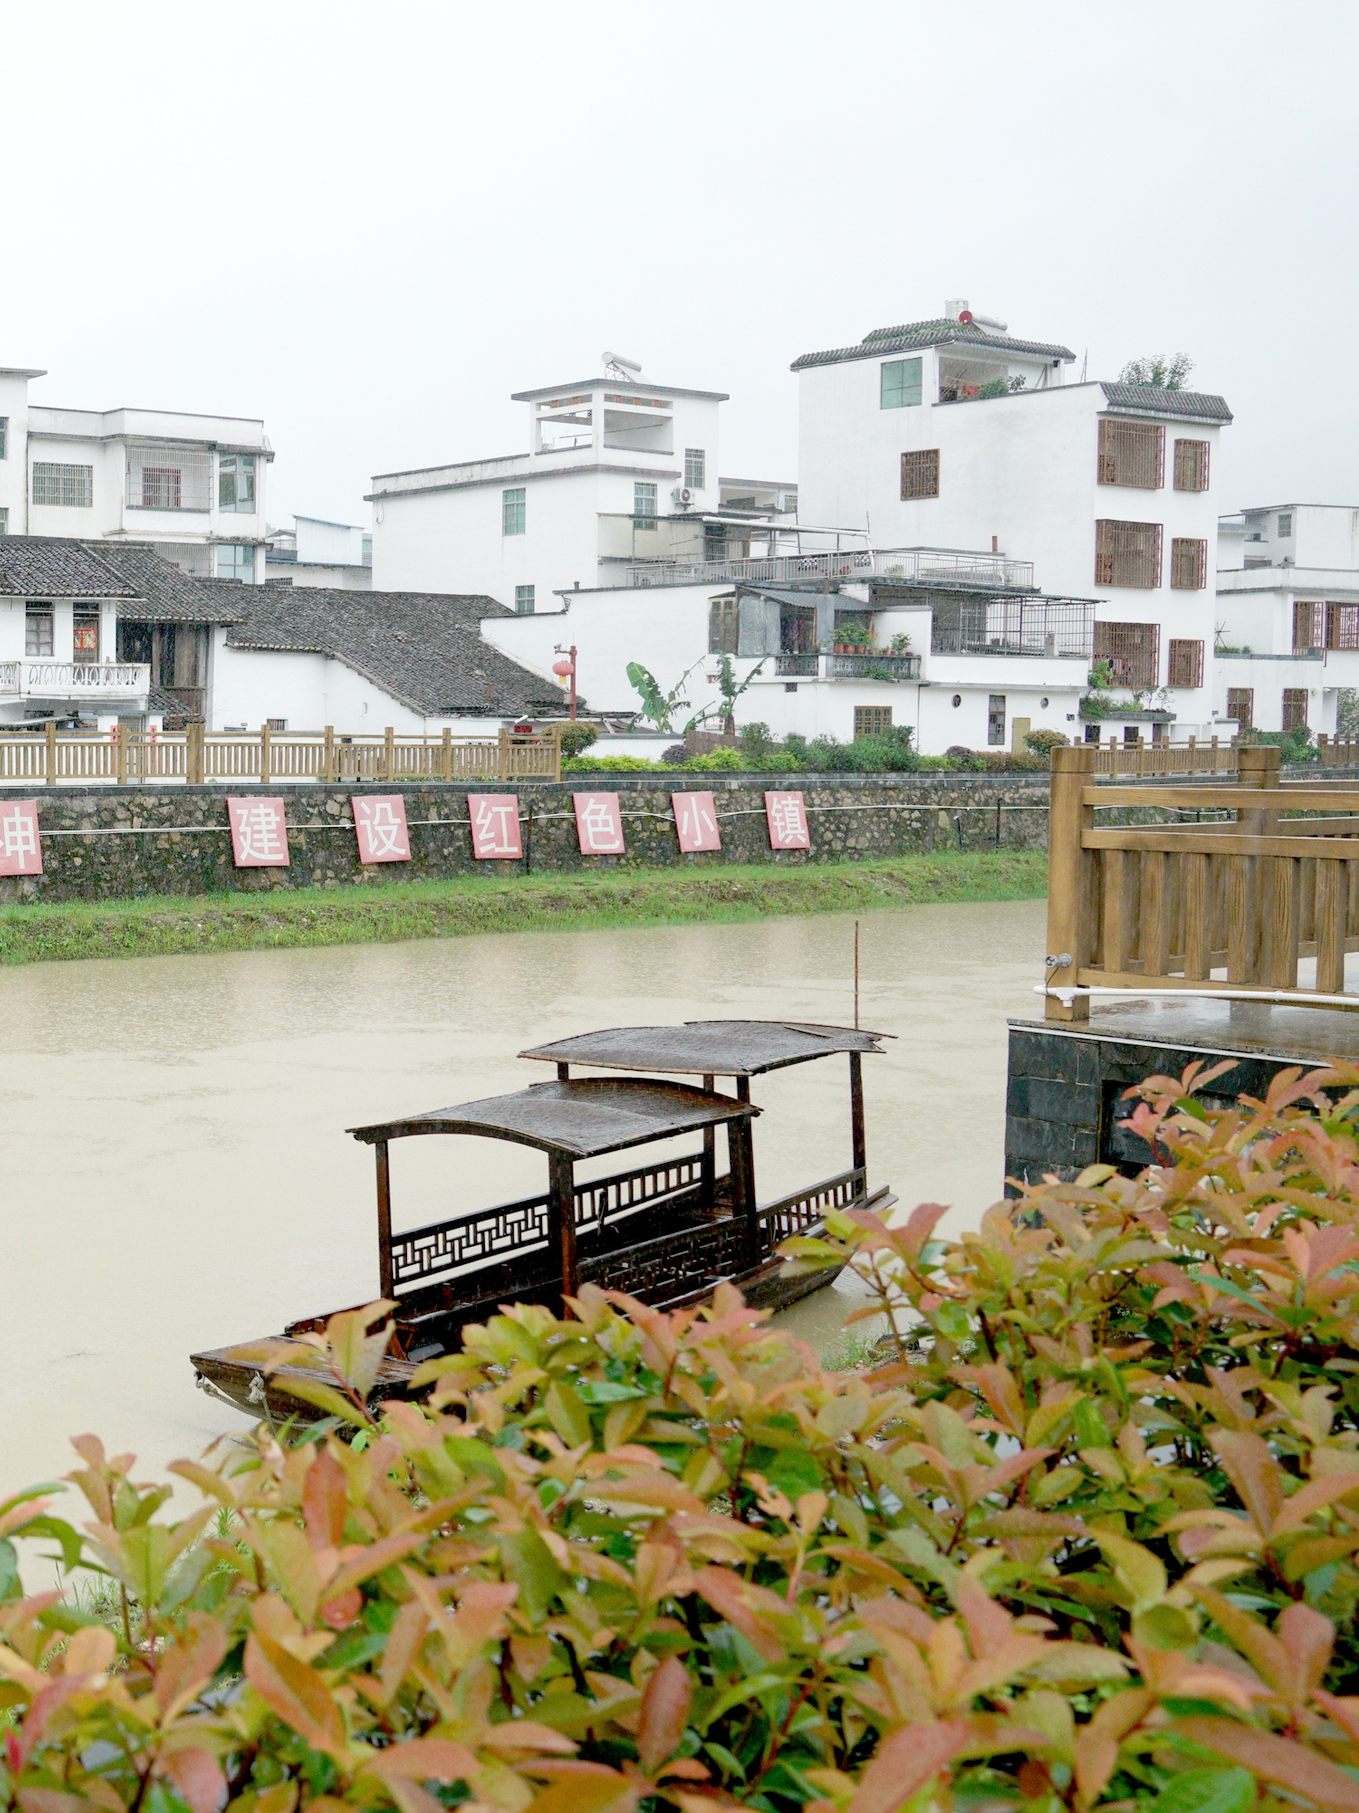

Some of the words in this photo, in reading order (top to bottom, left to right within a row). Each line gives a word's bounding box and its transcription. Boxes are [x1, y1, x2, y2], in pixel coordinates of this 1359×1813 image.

[235, 795, 807, 862] 建设红色小镇
